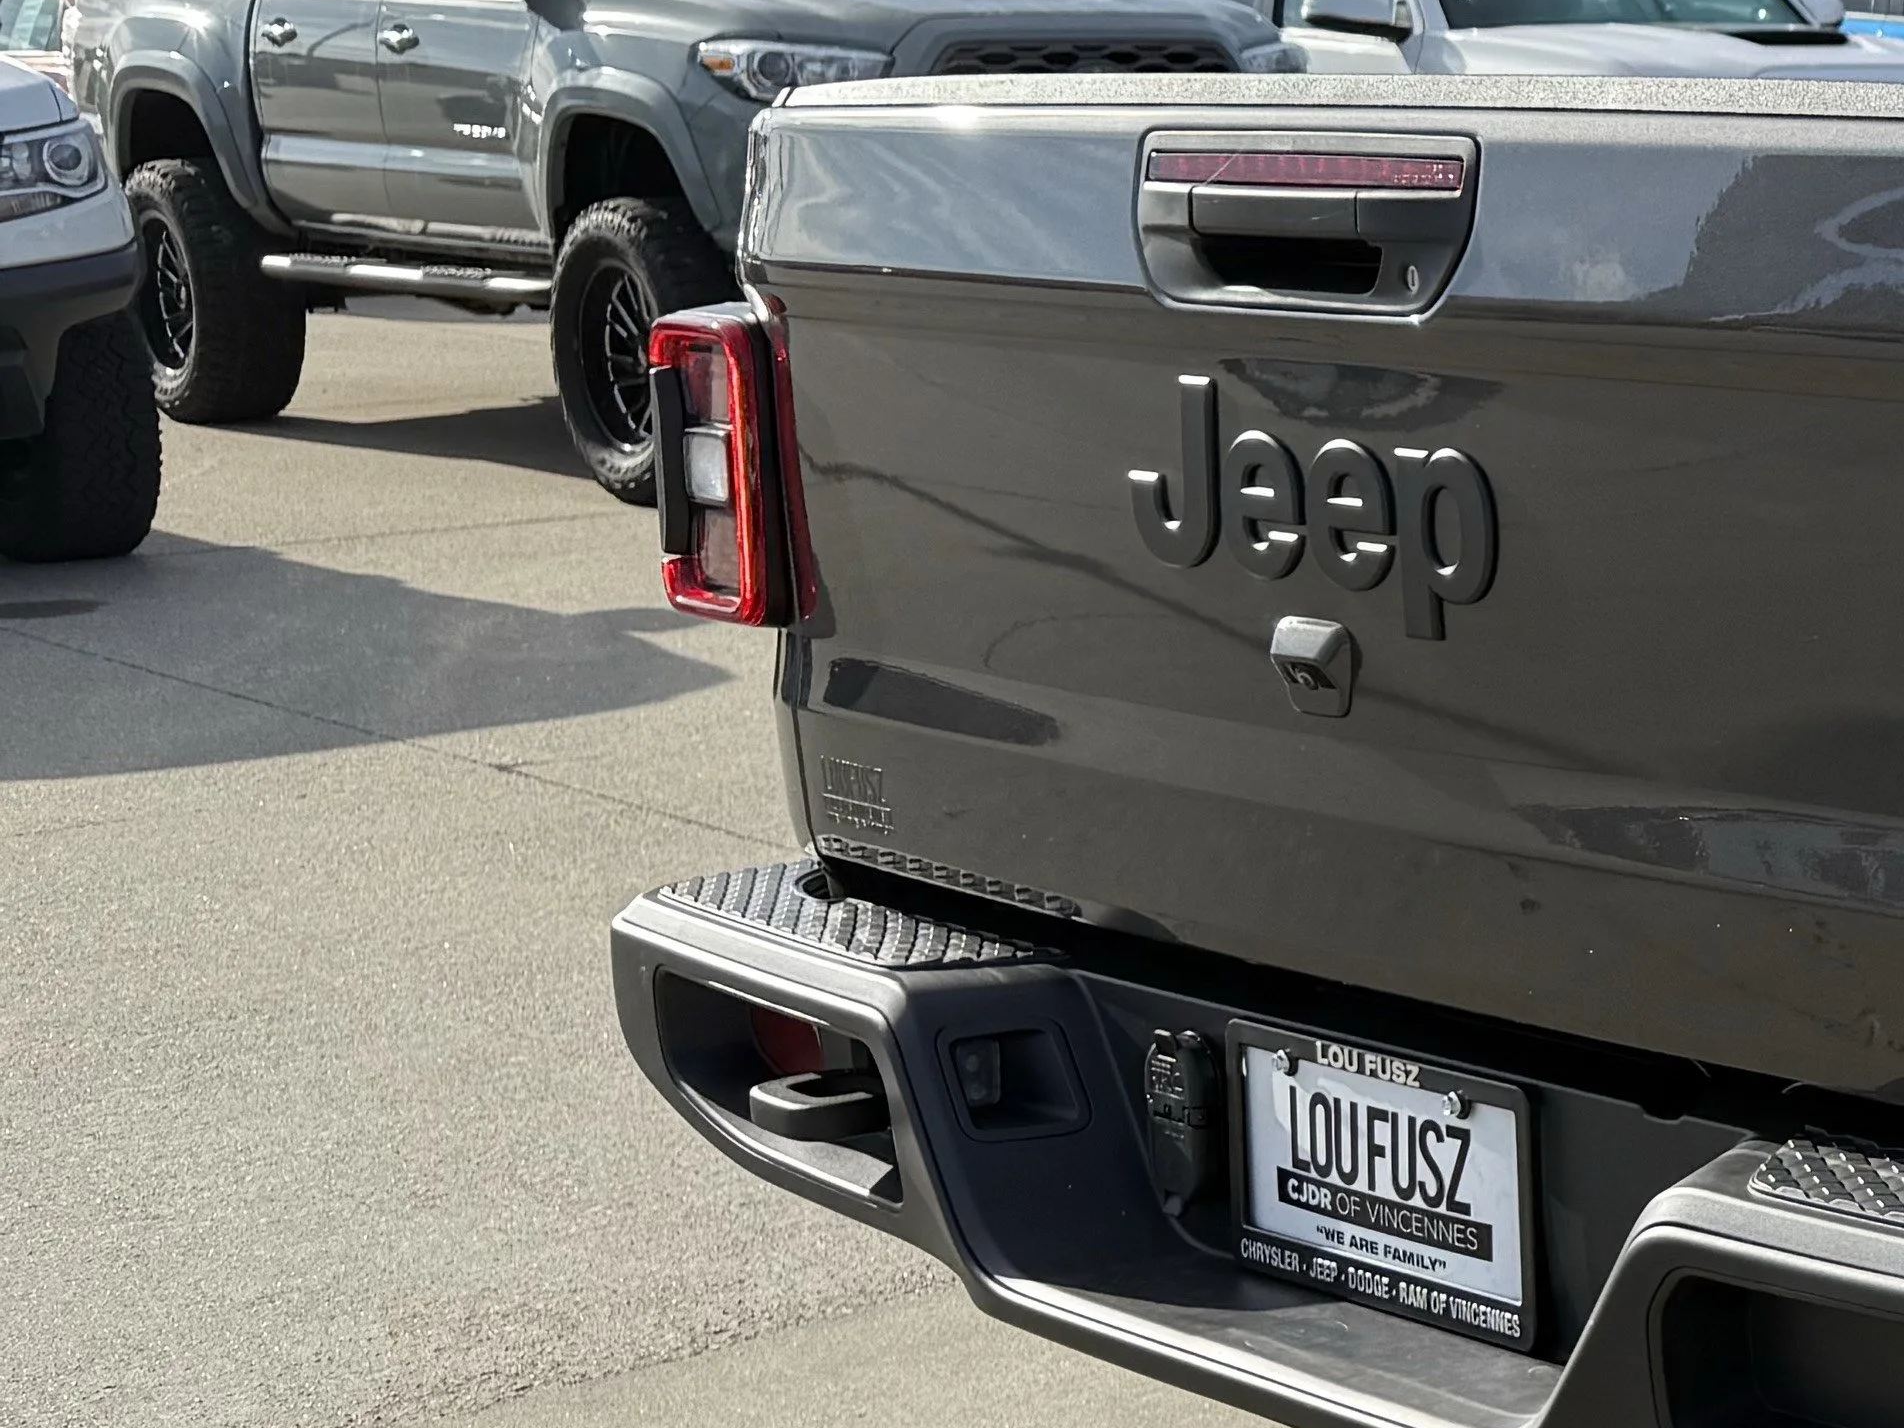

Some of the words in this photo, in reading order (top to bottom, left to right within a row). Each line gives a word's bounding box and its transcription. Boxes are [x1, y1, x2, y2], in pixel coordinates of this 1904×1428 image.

[1128, 375, 1499, 641] Jeep
[1316, 1041, 1358, 1073] LOU
[1364, 1058, 1421, 1088] FUSZ
[1289, 1085, 1358, 1186] LOU
[1366, 1105, 1472, 1217] FUSZ
[1287, 1178, 1332, 1211] CJDR
[1336, 1192, 1361, 1218] OF
[1365, 1199, 1478, 1251] VINCENNES
[1349, 1235, 1379, 1255] ARE
[1240, 1237, 1300, 1273] CHRYSLER
[1309, 1256, 1338, 1283] JEEP
[1348, 1266, 1390, 1299] DODGE
[1399, 1281, 1428, 1309] RAM
[1430, 1293, 1448, 1315] OF
[1449, 1298, 1521, 1338] VINCENNES
